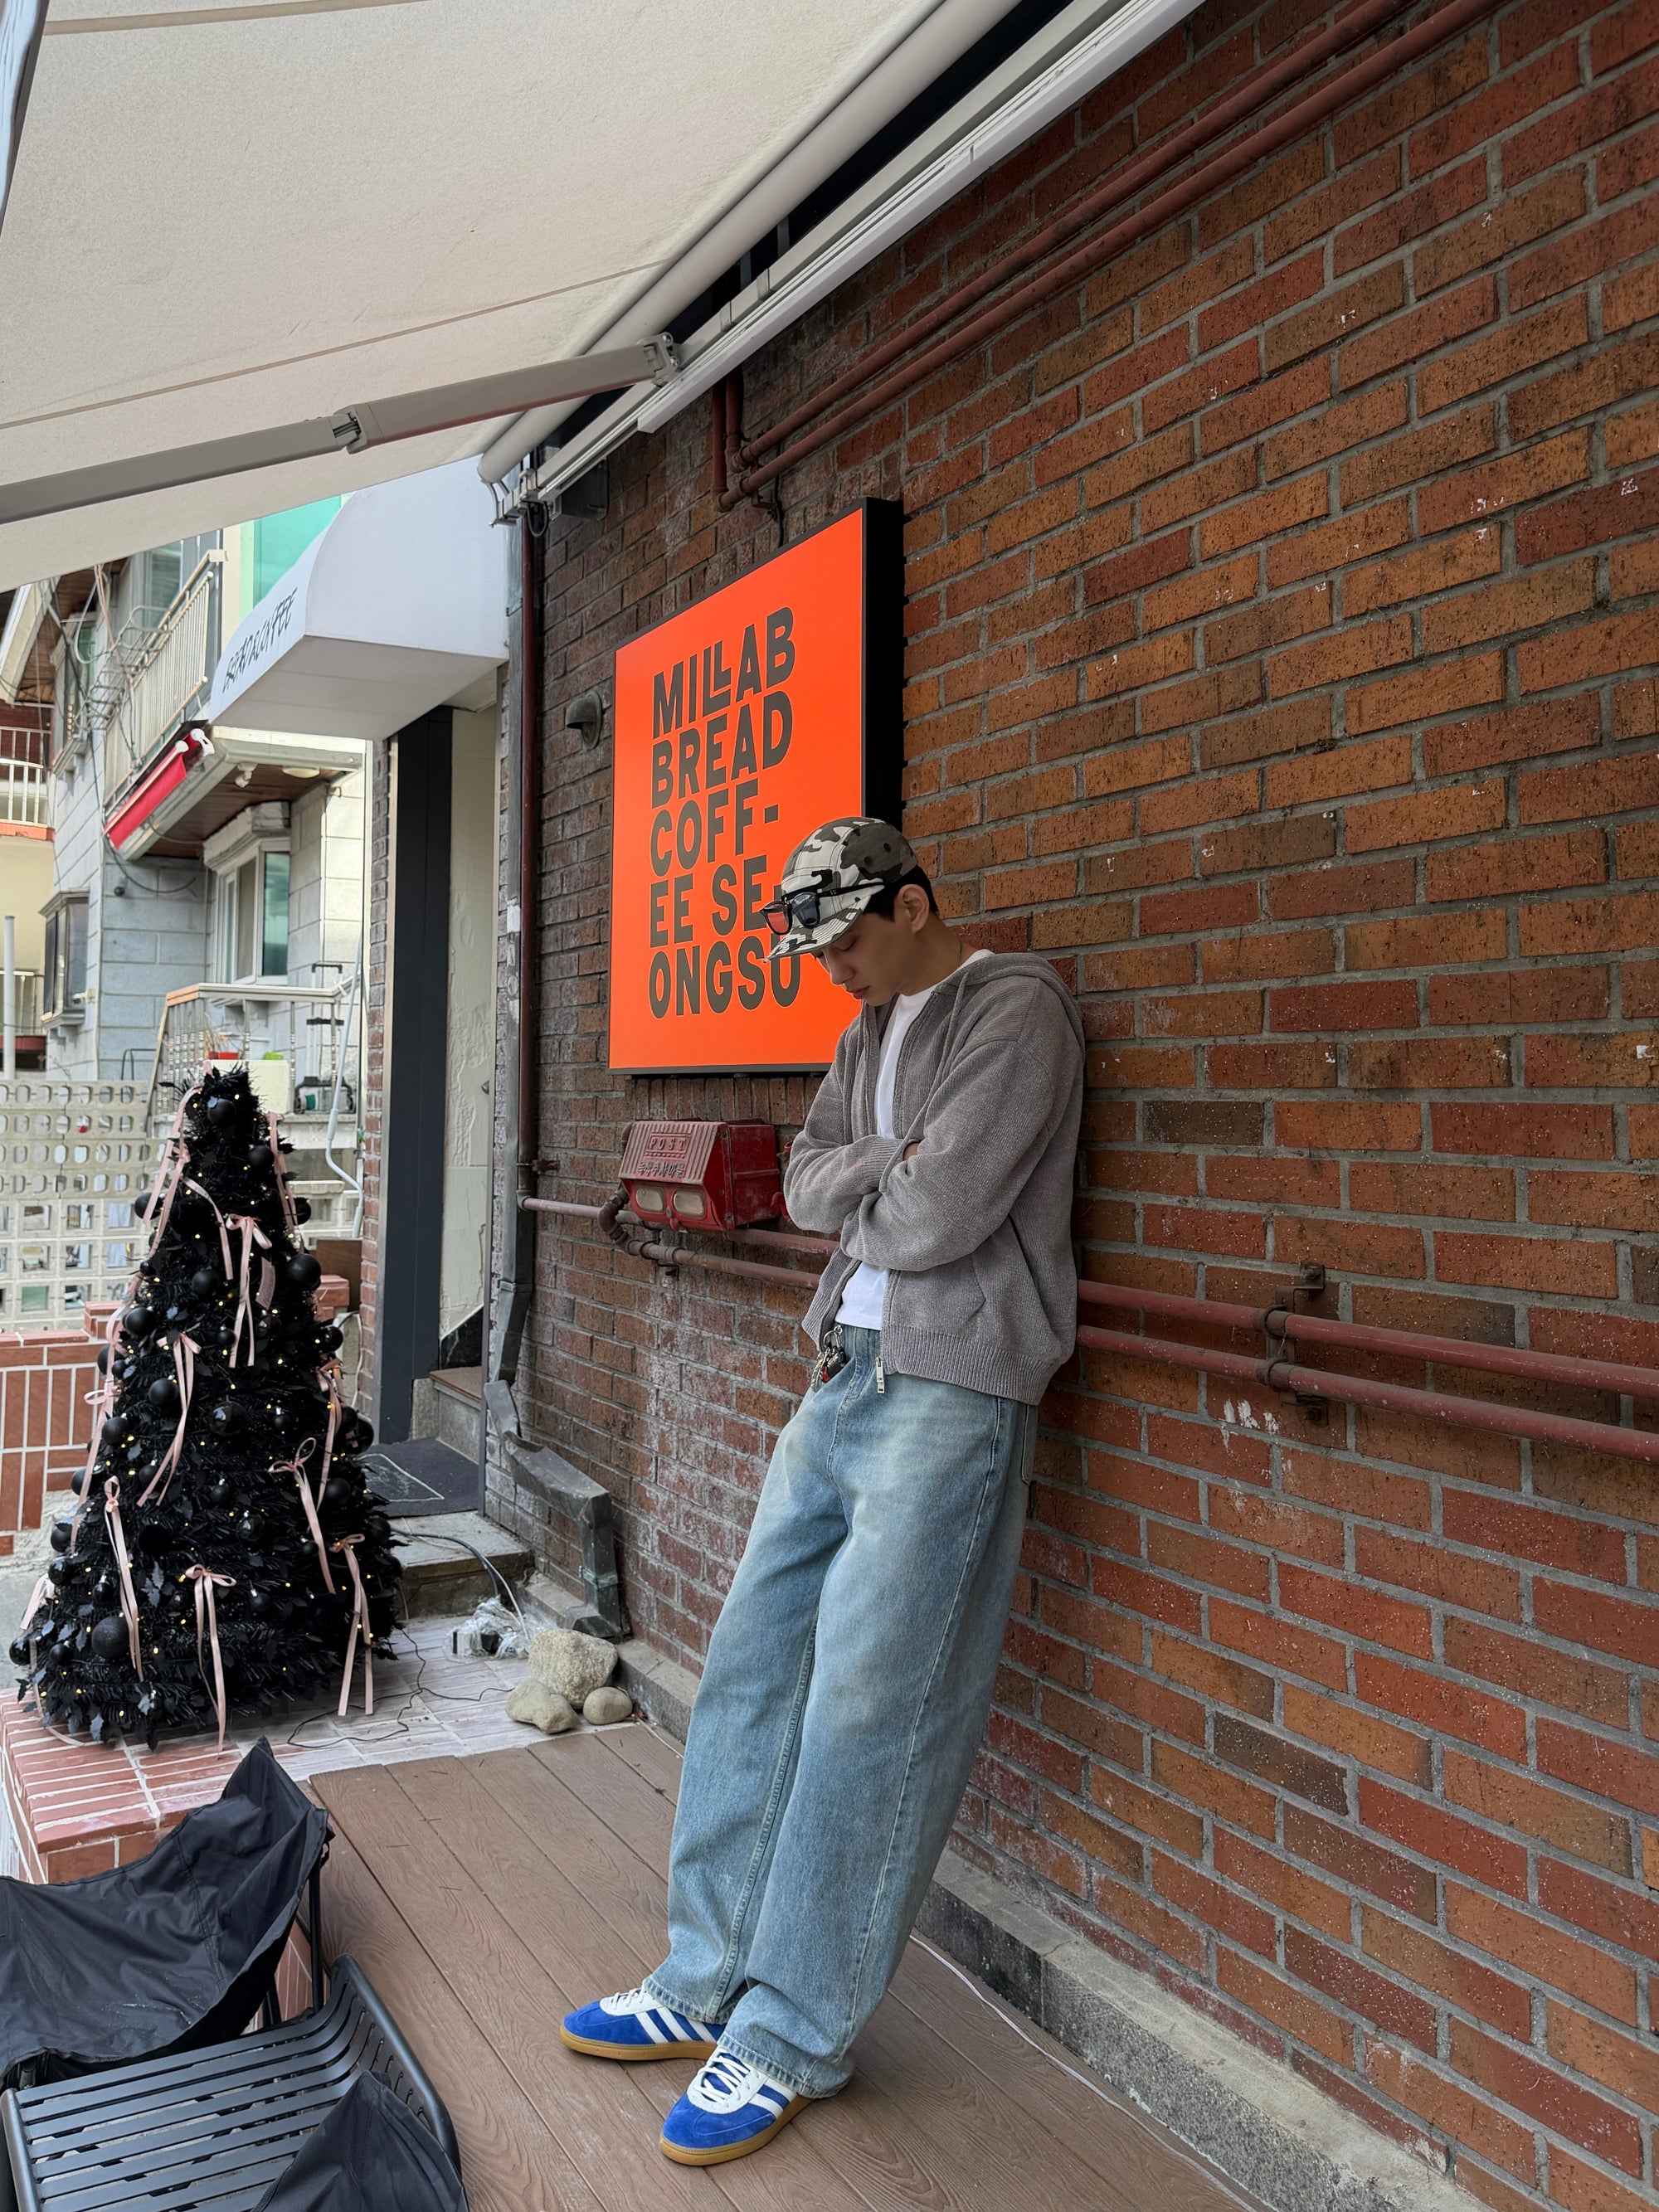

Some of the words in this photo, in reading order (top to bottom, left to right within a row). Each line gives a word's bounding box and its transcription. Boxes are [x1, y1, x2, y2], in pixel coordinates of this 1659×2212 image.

[653, 607, 795, 741] MILLAB
[651, 691, 793, 809] BREAD
[650, 778, 779, 878] COFF-
[650, 873, 693, 949] EE
[649, 933, 800, 1019] ONGSU
[649, 1137, 687, 1151] POST
